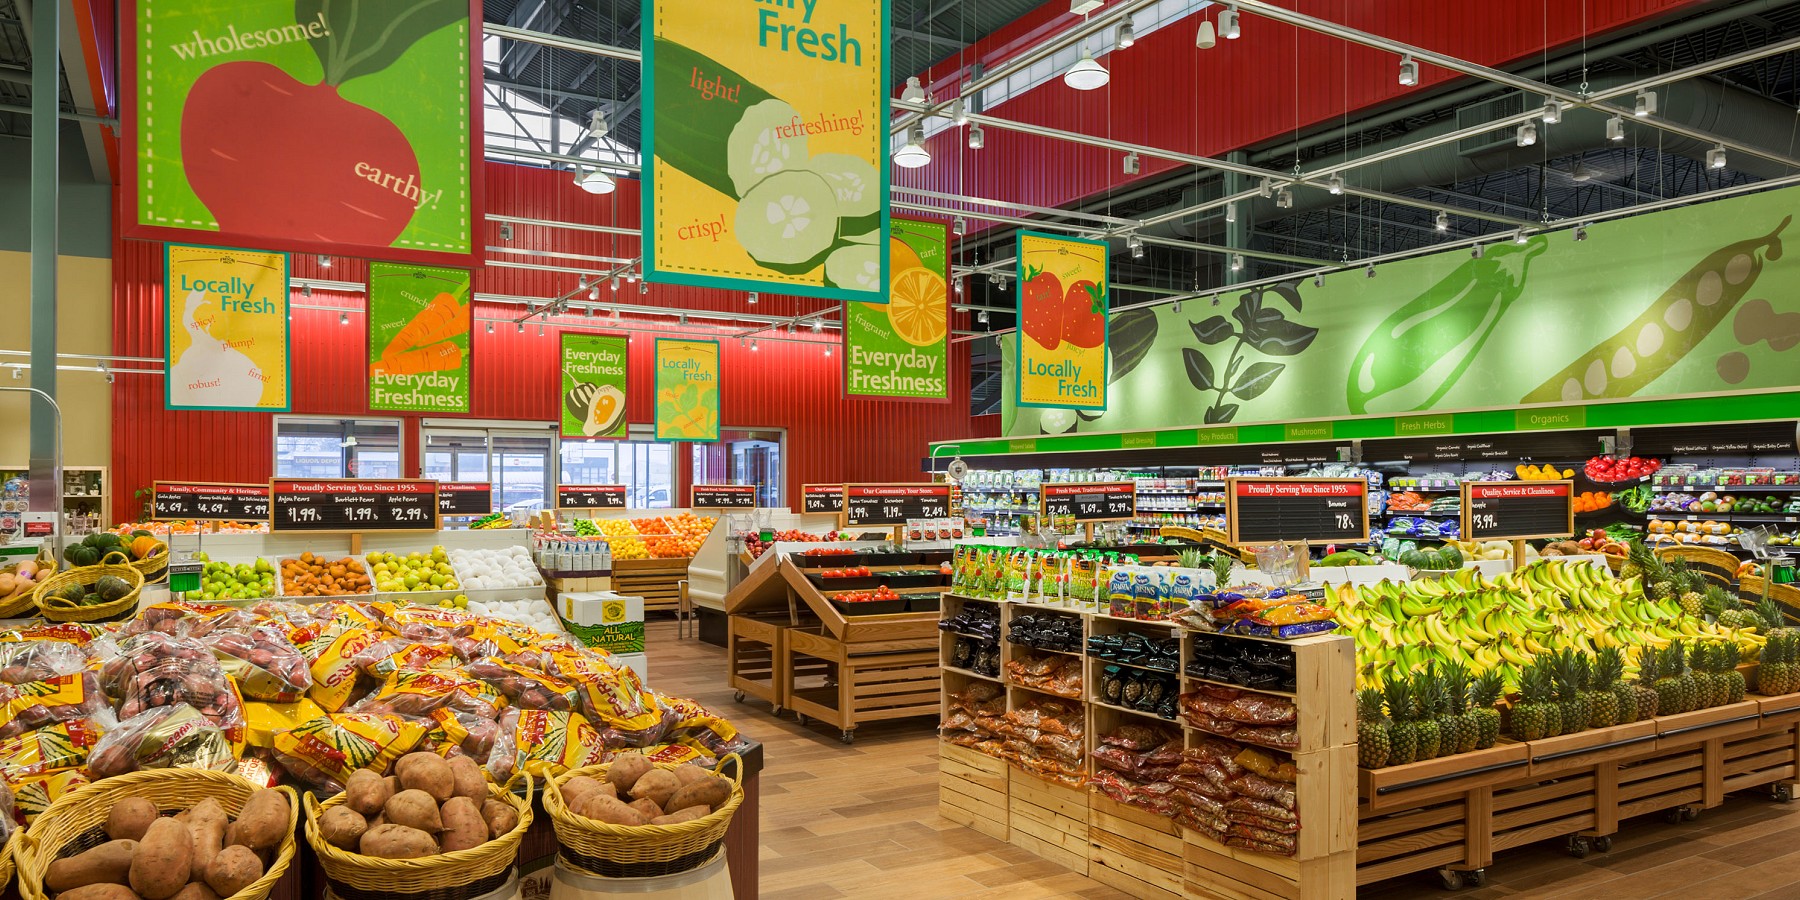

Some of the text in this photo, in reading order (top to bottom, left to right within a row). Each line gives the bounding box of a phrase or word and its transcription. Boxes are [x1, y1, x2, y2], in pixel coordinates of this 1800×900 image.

[171, 12, 331, 62] wholesome!
[759, 8, 862, 67] Fresh
[690, 67, 741, 103] light!
[775, 110, 865, 139] refreshing!
[354, 160, 443, 210] earthy!
[677, 214, 728, 242] crisp!
[920, 246, 937, 258] tart!
[1062, 264, 1082, 279] sweet!
[181, 275, 254, 298] Locally
[221, 296, 275, 314] Fresh
[400, 289, 436, 311] crunchy!
[190, 315, 216, 331] spicy!
[380, 318, 407, 331] sweet!
[855, 313, 891, 340] fragrant!
[222, 337, 256, 351] plump!
[439, 344, 457, 357] tart!
[1066, 342, 1086, 357] juicy!
[565, 348, 620, 364] Everyday
[852, 345, 938, 374] Everyday
[566, 362, 624, 376] Freshness
[662, 358, 700, 372] Locally
[1028, 358, 1082, 382] Locally
[247, 367, 271, 383] firm!
[374, 369, 459, 392] Everyday
[683, 370, 712, 381] Fresh
[852, 369, 942, 392] Freshness
[188, 378, 221, 391] robust!
[1058, 380, 1097, 398] Fresh
[375, 388, 464, 407] Freshness
[1401, 421, 1446, 431] Fresh Herbs
[1530, 414, 1569, 425] Organics
[1200, 432, 1235, 442] Soy Products
[1291, 427, 1327, 437] Mushrooms
[192, 486, 227, 494] Community
[292, 483, 325, 492] Proudly
[326, 484, 357, 493] Serving
[1248, 484, 1348, 496] Proudly Serving You Since 1955.
[1481, 488, 1503, 498] Quality,
[1527, 487, 1556, 495] Cleanliness.
[277, 495, 293, 503] Anjou
[288, 507, 316, 522] $1.99
[345, 507, 372, 520] $1.99
[391, 507, 422, 521] $2.99
[848, 506, 865, 518] $1.99
[922, 506, 943, 517] $2.49
[1335, 513, 1349, 529] 78
[1472, 514, 1493, 529] $3.99
[591, 633, 636, 643] NATURAL
[604, 626, 620, 635] ALL
[308, 738, 330, 754] RED
